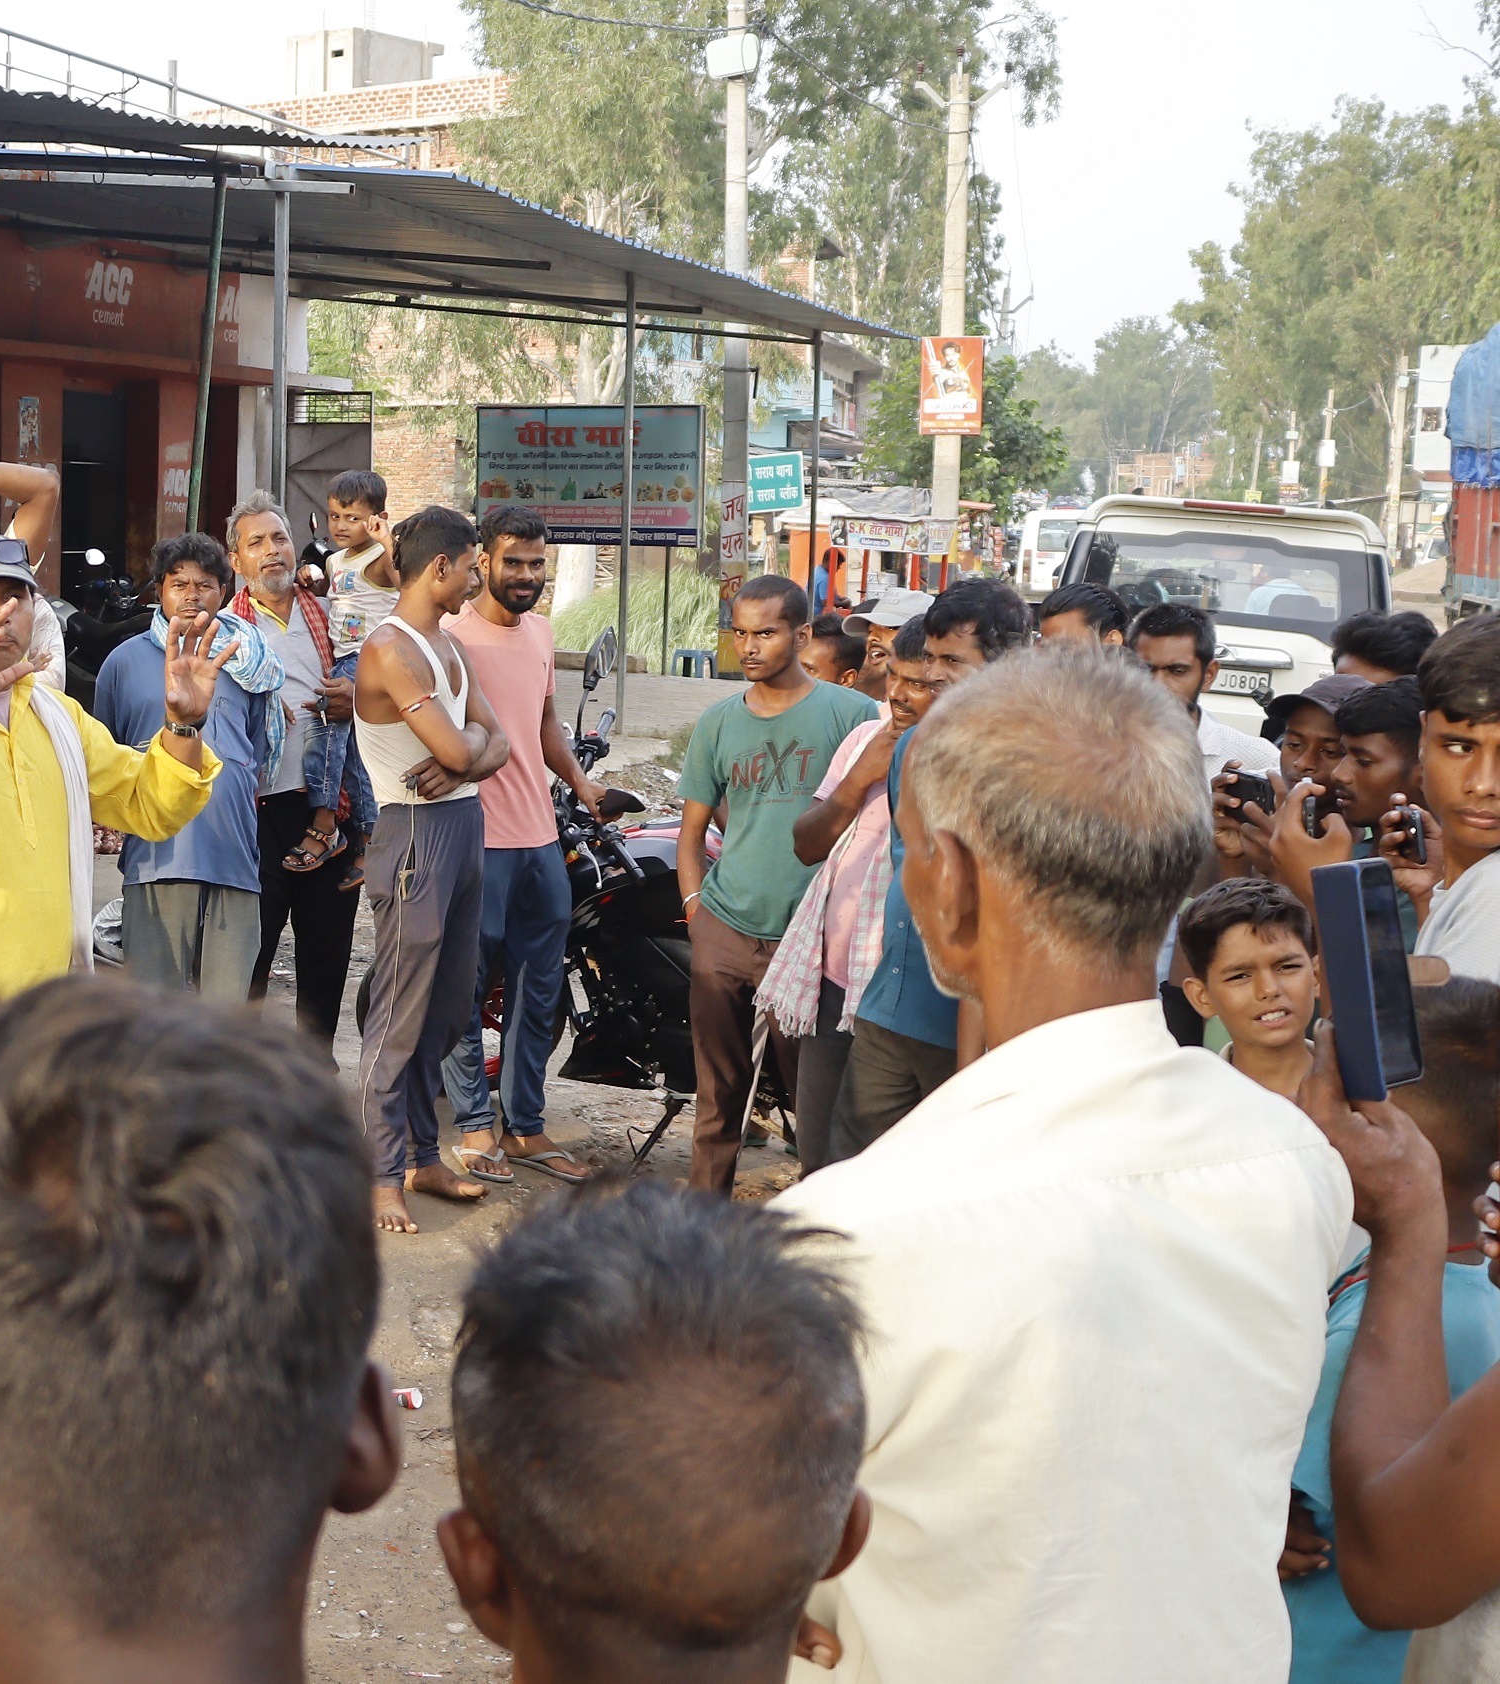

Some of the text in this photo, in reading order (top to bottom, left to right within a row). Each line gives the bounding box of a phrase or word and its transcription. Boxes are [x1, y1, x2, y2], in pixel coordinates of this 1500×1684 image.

[85, 260, 134, 305] ACC
[93, 307, 125, 327] cement
[515, 420, 578, 448] वीरा
[755, 466, 774, 480] सराय
[776, 464, 793, 477] थाना
[722, 494, 745, 522] जय
[757, 489, 776, 502] सराय
[731, 736, 816, 795] NEXT
